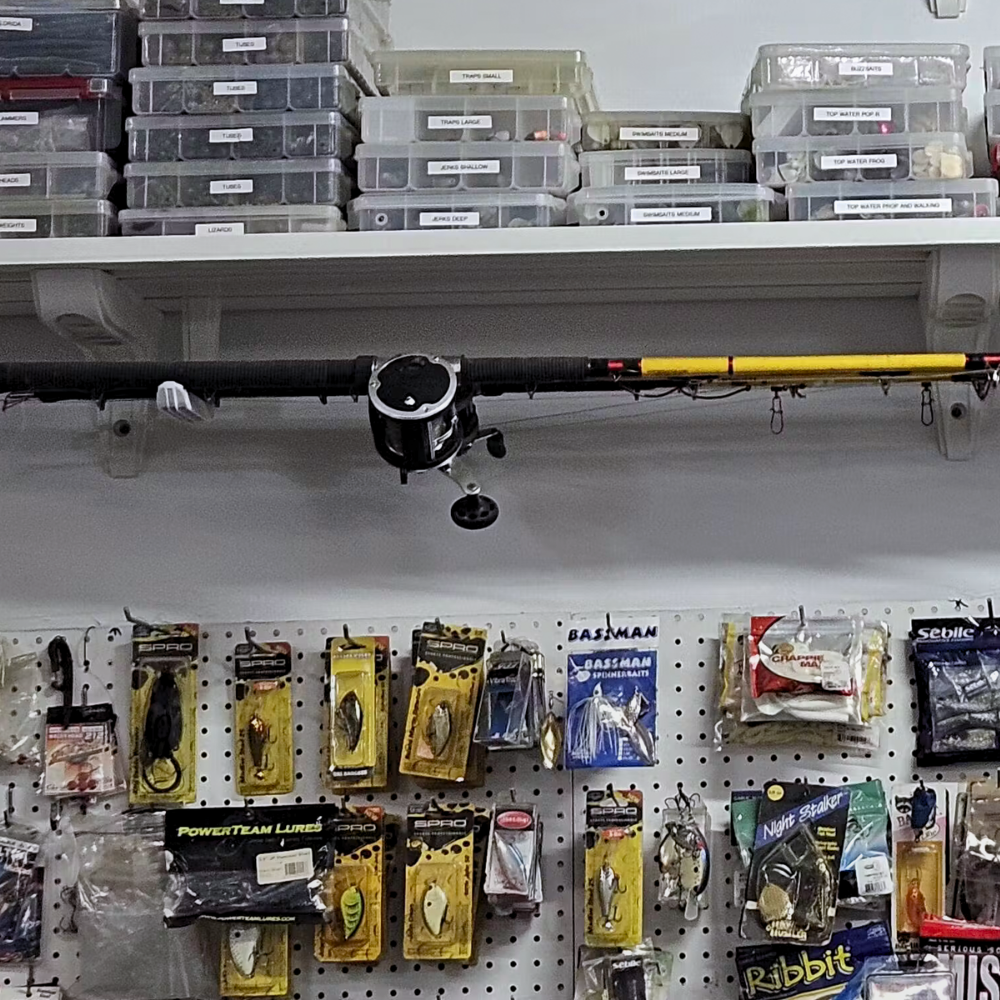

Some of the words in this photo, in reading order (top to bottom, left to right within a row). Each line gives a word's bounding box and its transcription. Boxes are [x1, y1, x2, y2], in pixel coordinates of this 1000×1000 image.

[568, 626, 658, 641] BASSMAN
[917, 627, 974, 639] sebile
[138, 643, 193, 652] SPRO
[427, 639, 479, 654] SPRO
[240, 658, 286, 667] SPRO
[584, 657, 652, 670] BASSMAN
[592, 669, 649, 679] SPINNERBAITS
[589, 807, 637, 815] SPRO
[799, 793, 843, 822] Stalker
[336, 823, 377, 832] PRO
[414, 819, 467, 828] SPRO
[937, 945, 982, 953] SERIOUS
[745, 945, 854, 997] Ribbit
